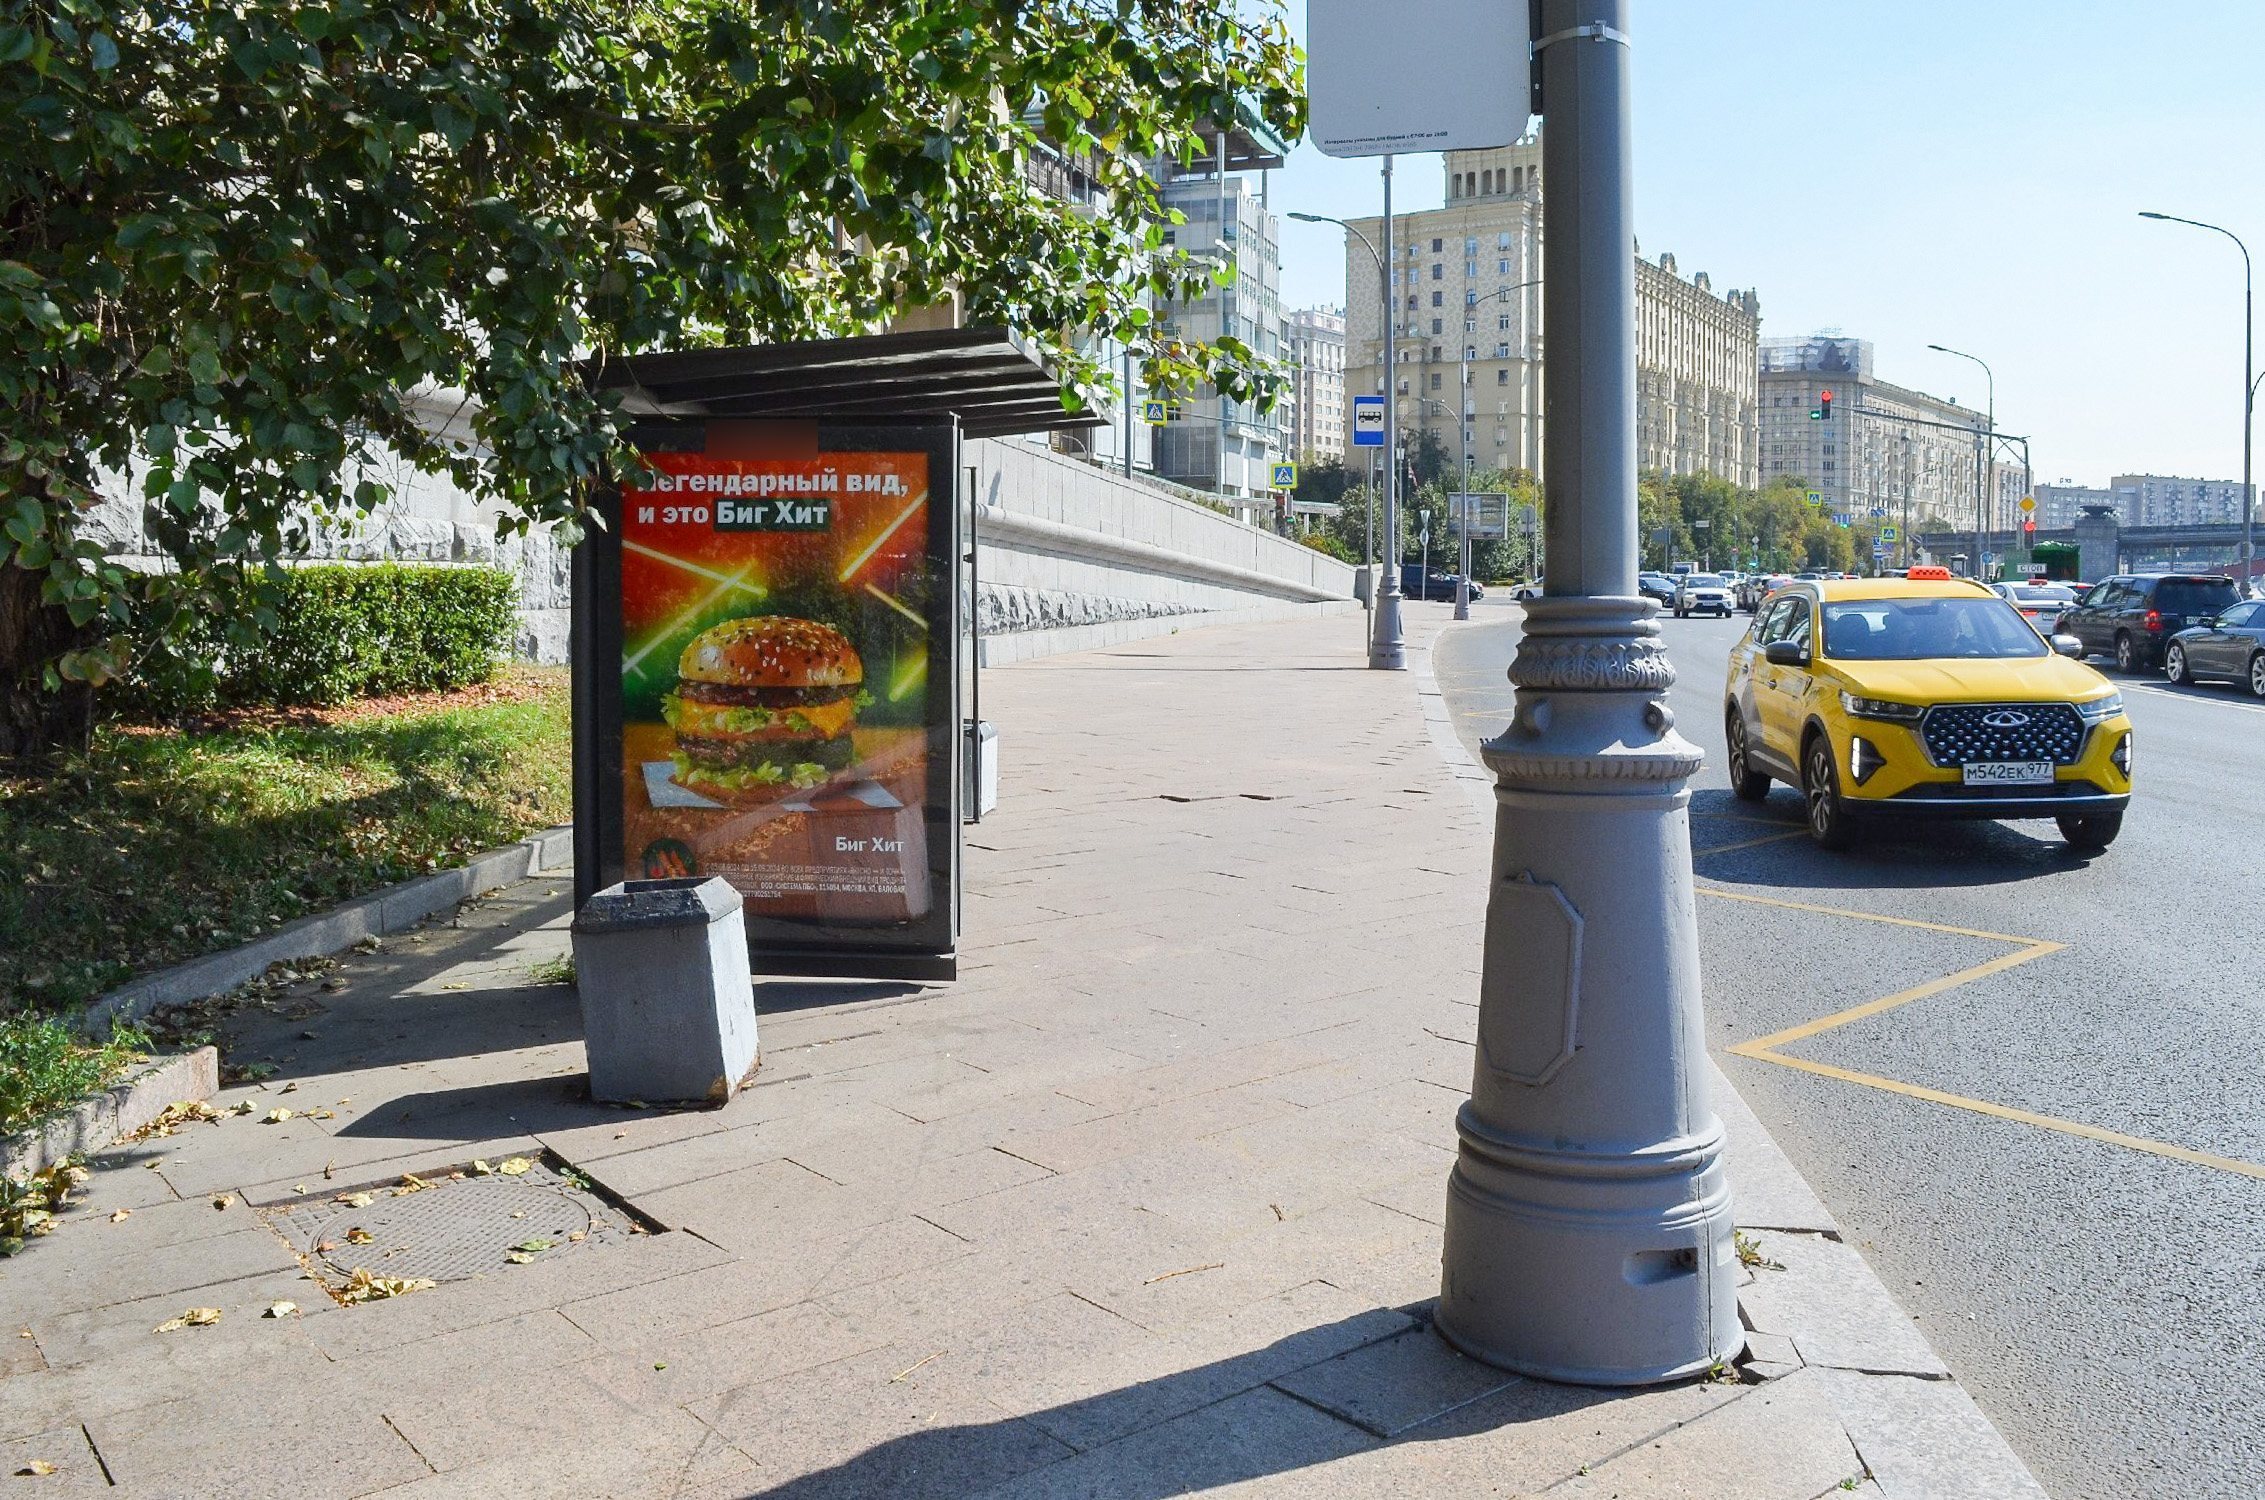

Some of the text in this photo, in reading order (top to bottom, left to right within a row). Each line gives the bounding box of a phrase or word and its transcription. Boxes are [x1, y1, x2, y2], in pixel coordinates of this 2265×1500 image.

[846, 474, 909, 497] вид,
[638, 501, 828, 524] и это Биг Хит
[2020, 564, 2043, 572] СТОП
[1967, 762, 2050, 779] М542ЕК 977
[835, 836, 905, 852] Биг Хит
[760, 882, 773, 890] ООО
